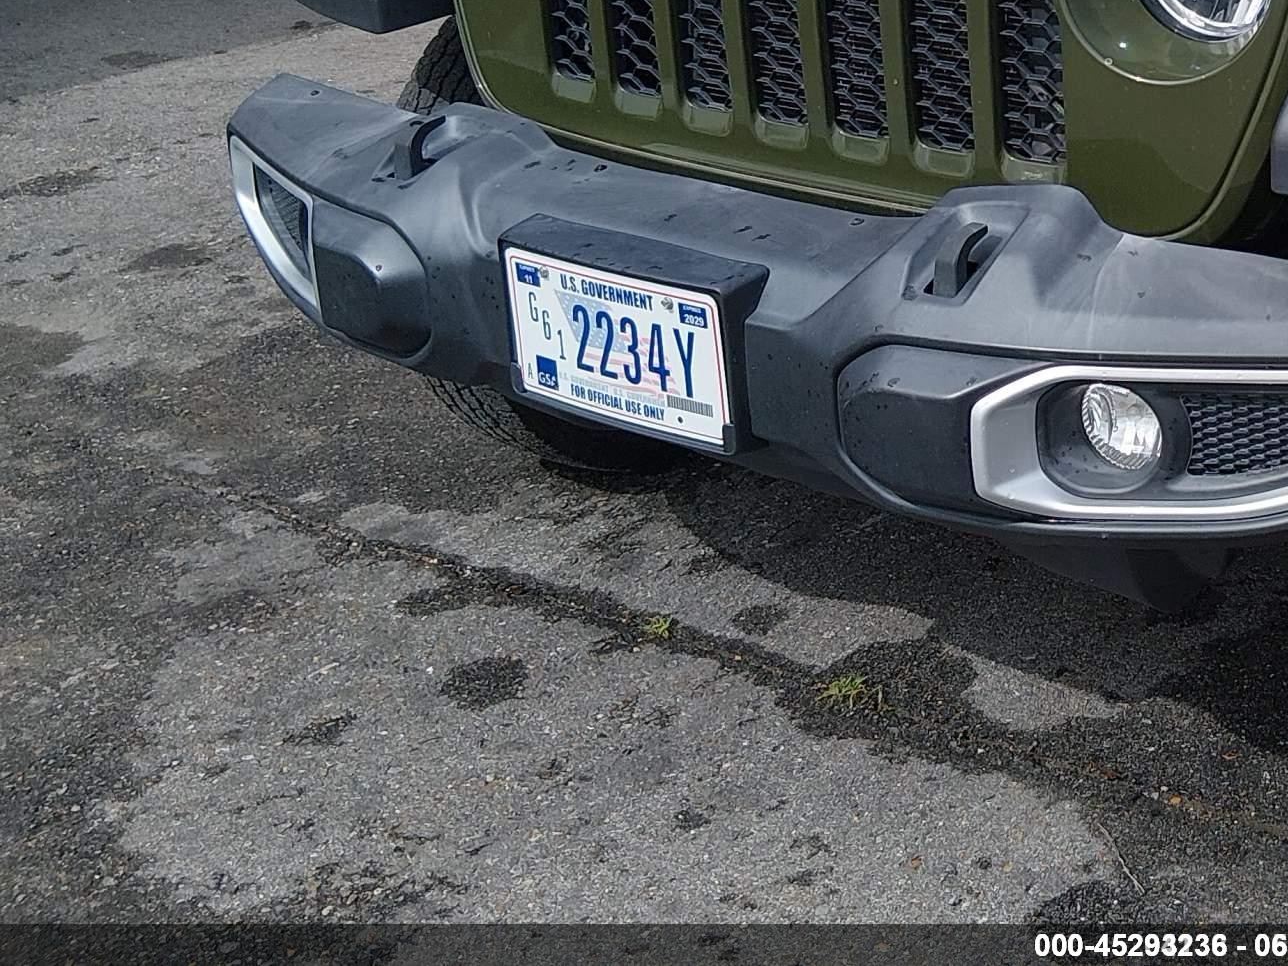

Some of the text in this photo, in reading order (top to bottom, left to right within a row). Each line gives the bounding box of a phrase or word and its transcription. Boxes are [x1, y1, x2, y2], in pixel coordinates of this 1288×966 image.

[524, 274, 533, 284] 11
[560, 274, 654, 312] U.S. GOVERNMENT
[683, 313, 705, 327] 2029
[572, 303, 695, 398] 2234Y
[538, 371, 557, 389] GSA
[570, 382, 586, 400] FOR
[587, 387, 624, 411] OFFICIAL
[625, 399, 643, 416] USE
[643, 404, 666, 422] ONLY
